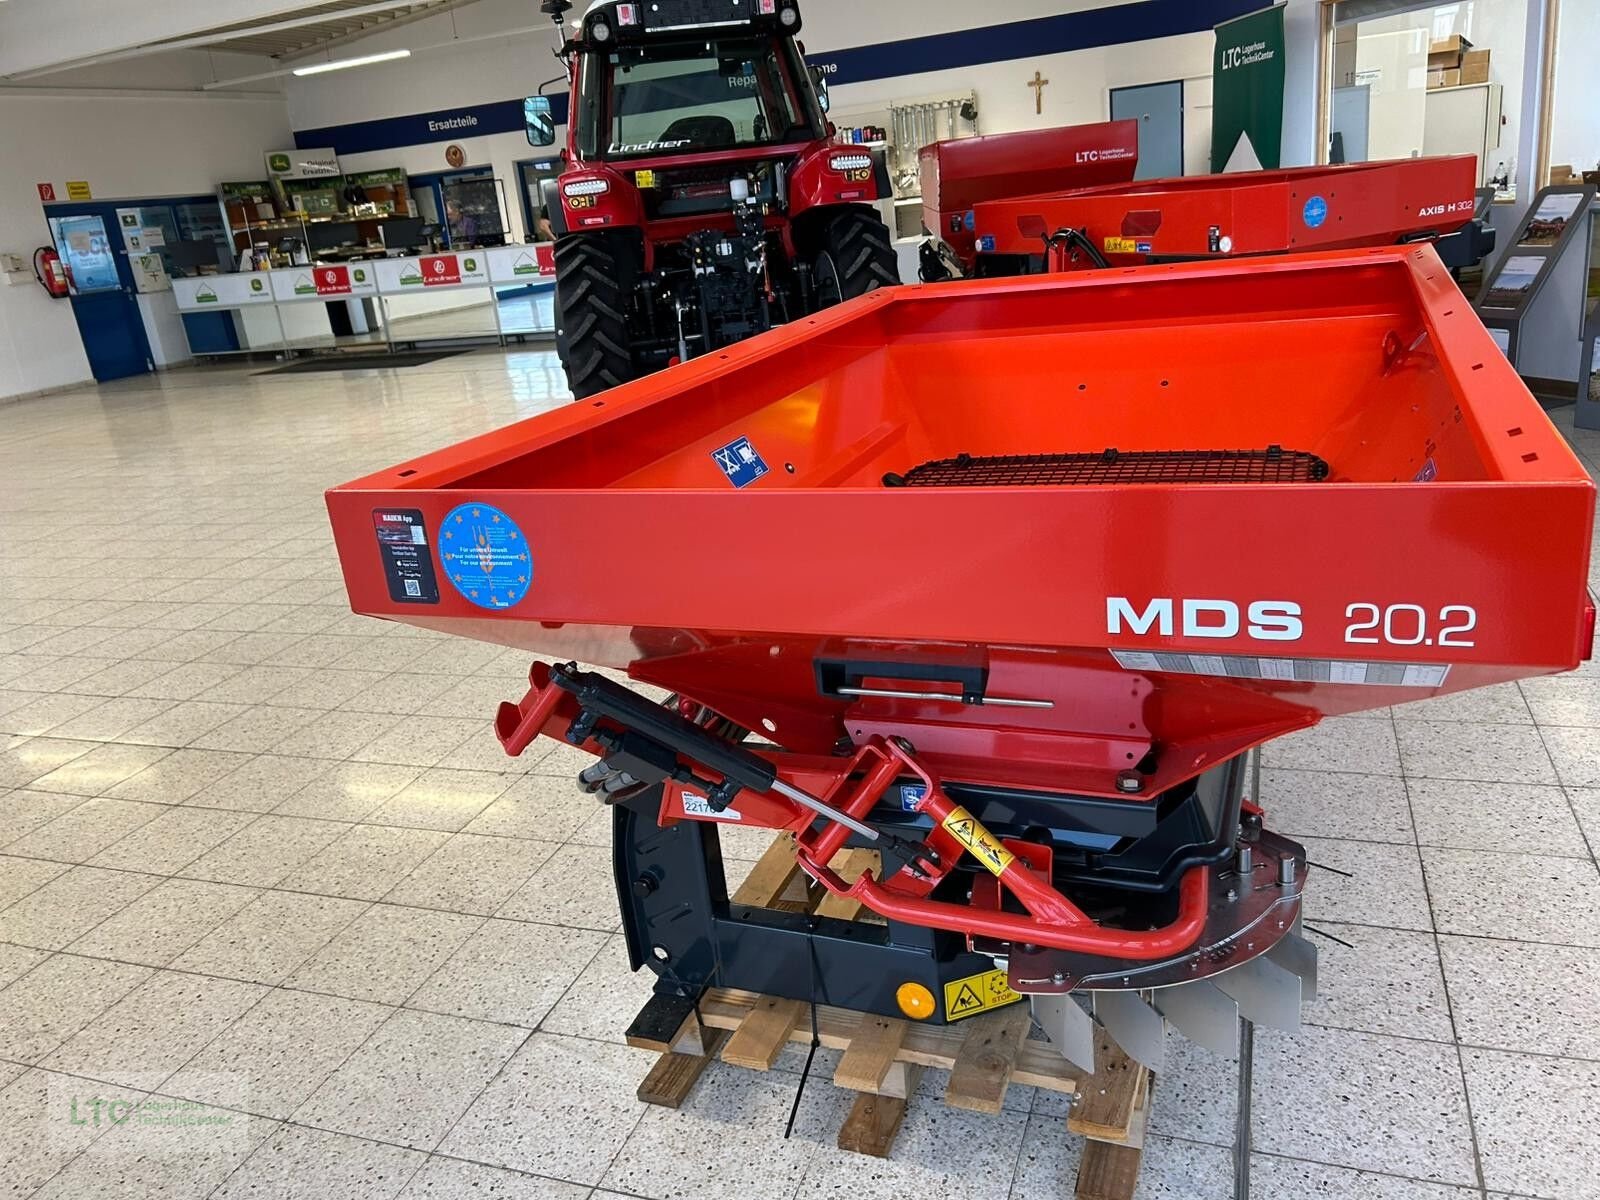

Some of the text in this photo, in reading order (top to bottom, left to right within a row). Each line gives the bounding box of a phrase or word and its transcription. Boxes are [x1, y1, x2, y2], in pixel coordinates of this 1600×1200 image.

[1222, 46, 1241, 70] LTC
[428, 115, 478, 131] Ersatzteile
[607, 139, 691, 154] Lindner
[1075, 150, 1098, 163] LTC
[1418, 205, 1446, 217] AXIS
[1447, 203, 1456, 212] H
[1106, 597, 1477, 647] MDS 20.2
[991, 992, 1012, 1004] STOP
